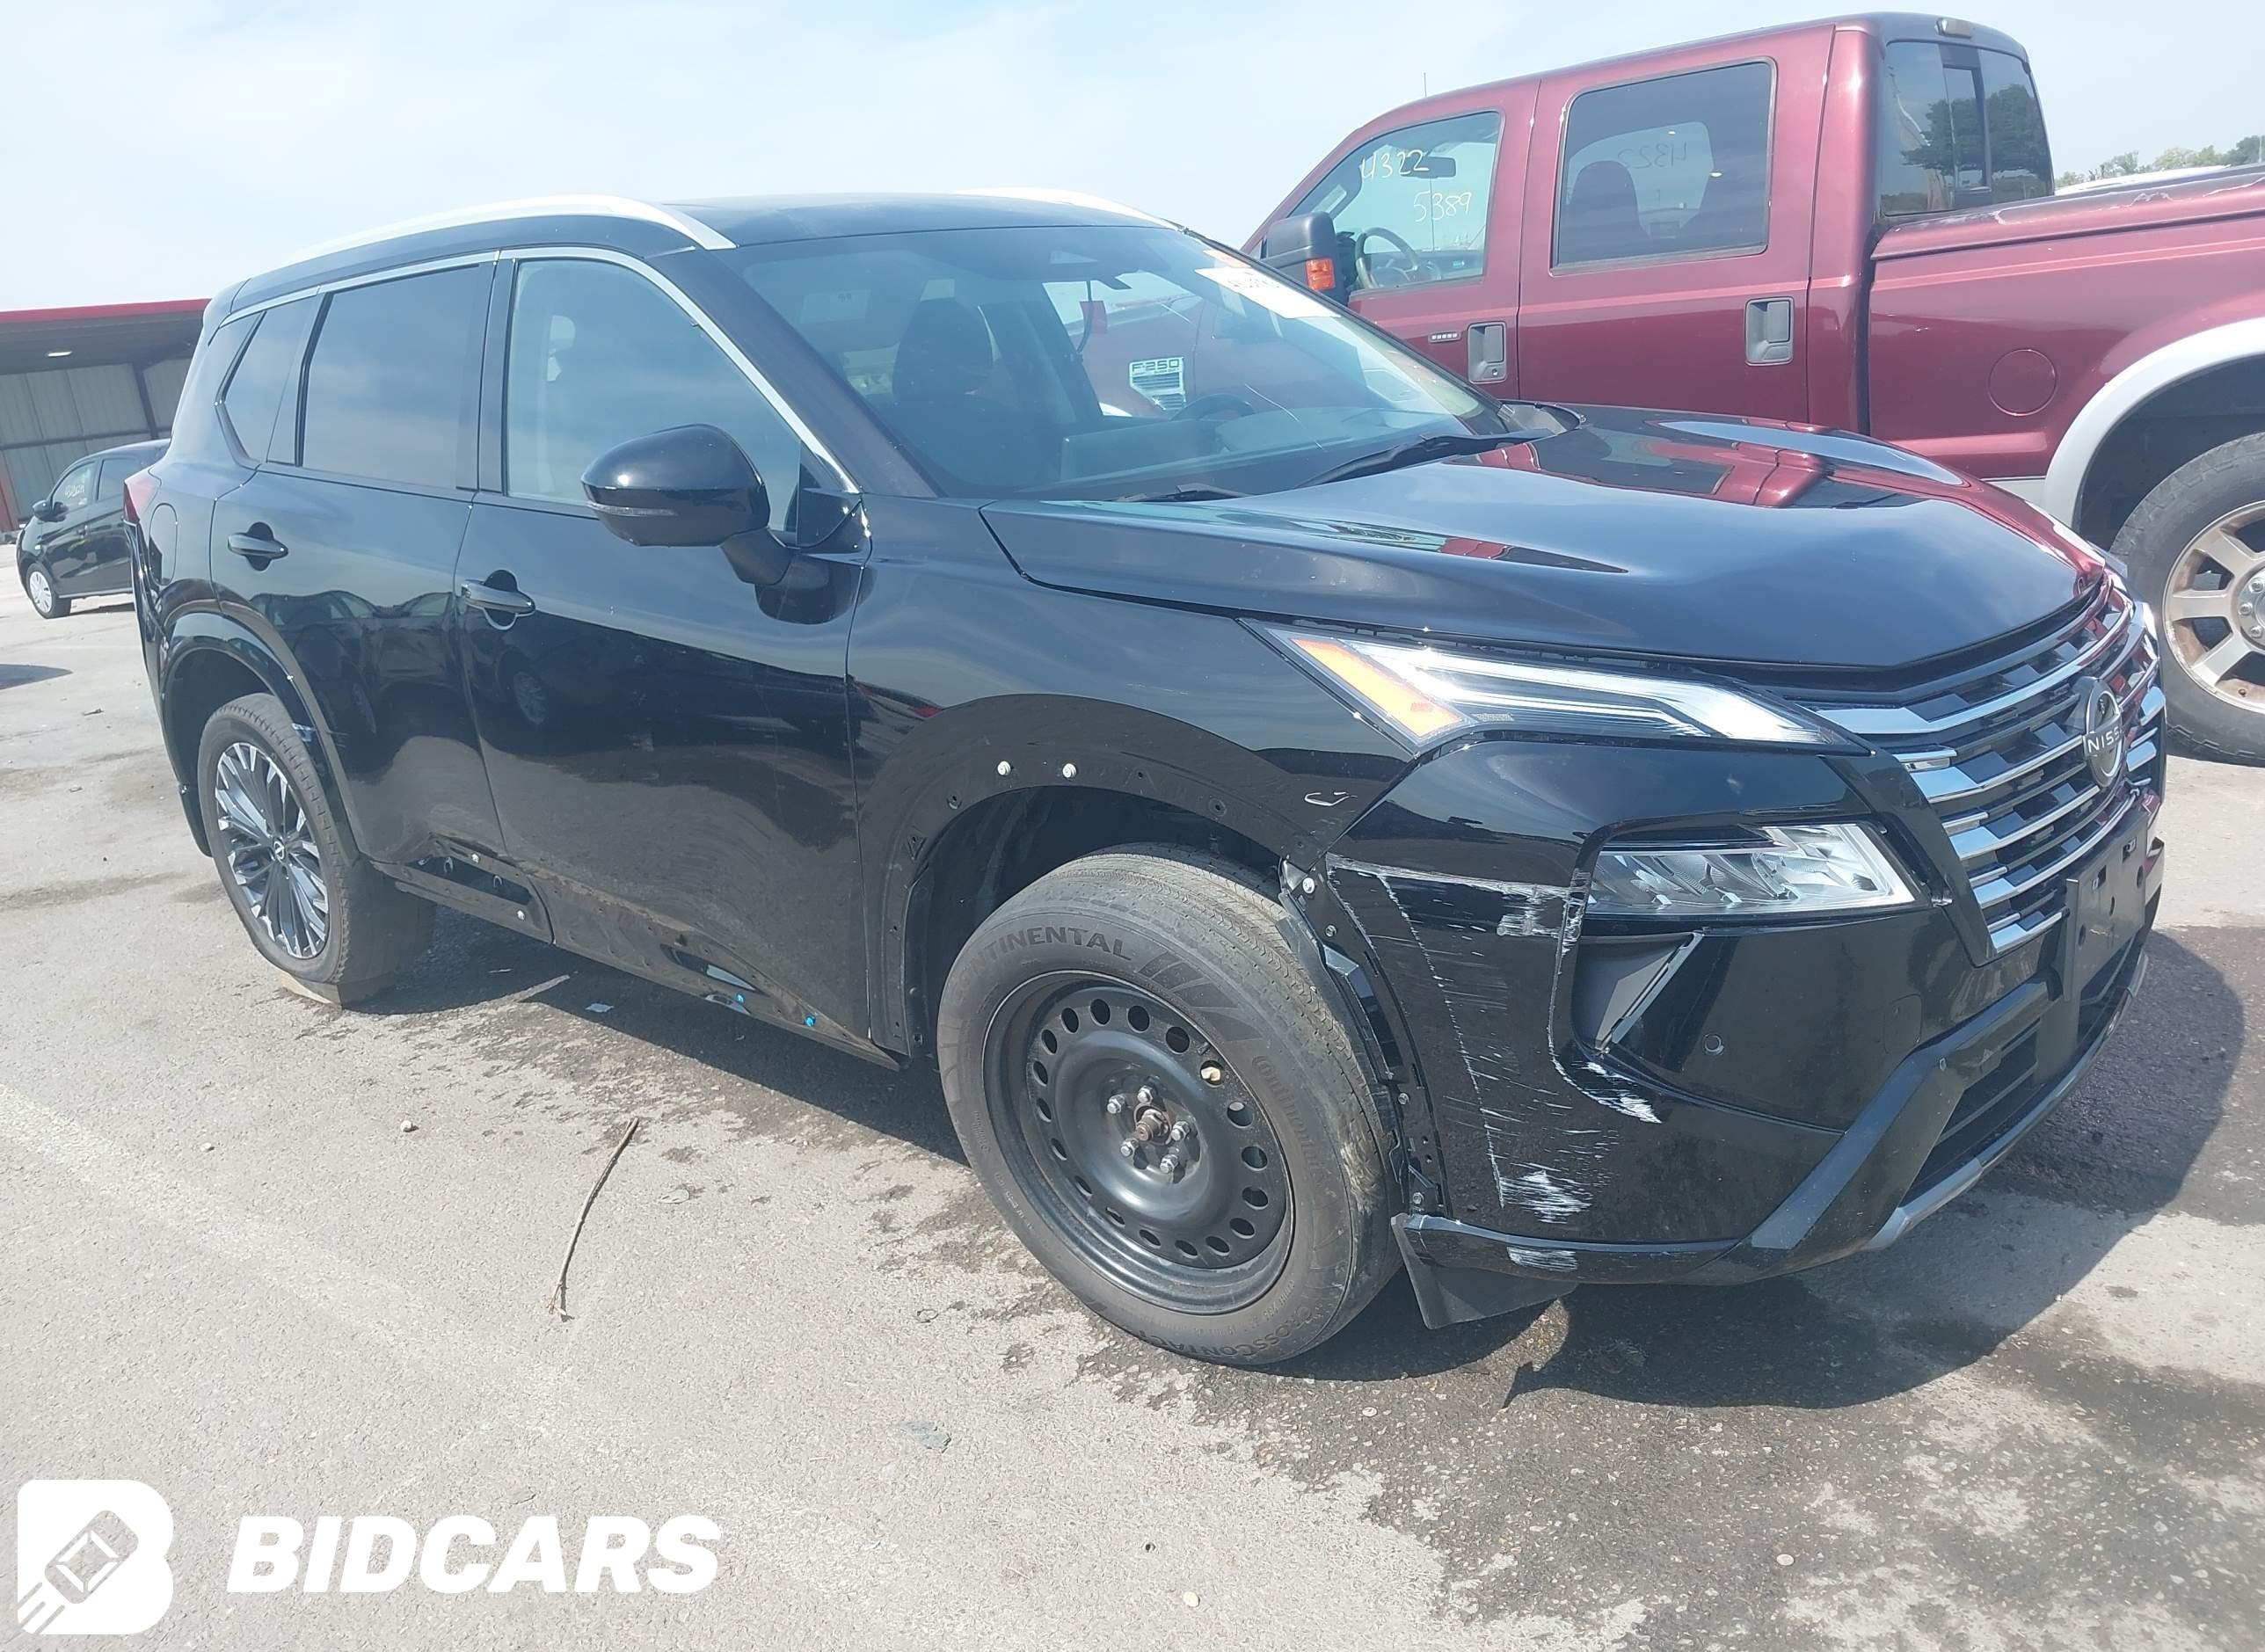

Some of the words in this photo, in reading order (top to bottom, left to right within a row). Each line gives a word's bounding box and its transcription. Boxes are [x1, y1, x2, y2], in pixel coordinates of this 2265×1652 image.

[1359, 149, 1430, 179] 4322
[1413, 190, 1473, 222] 5389
[2087, 725, 2123, 753] NISS
